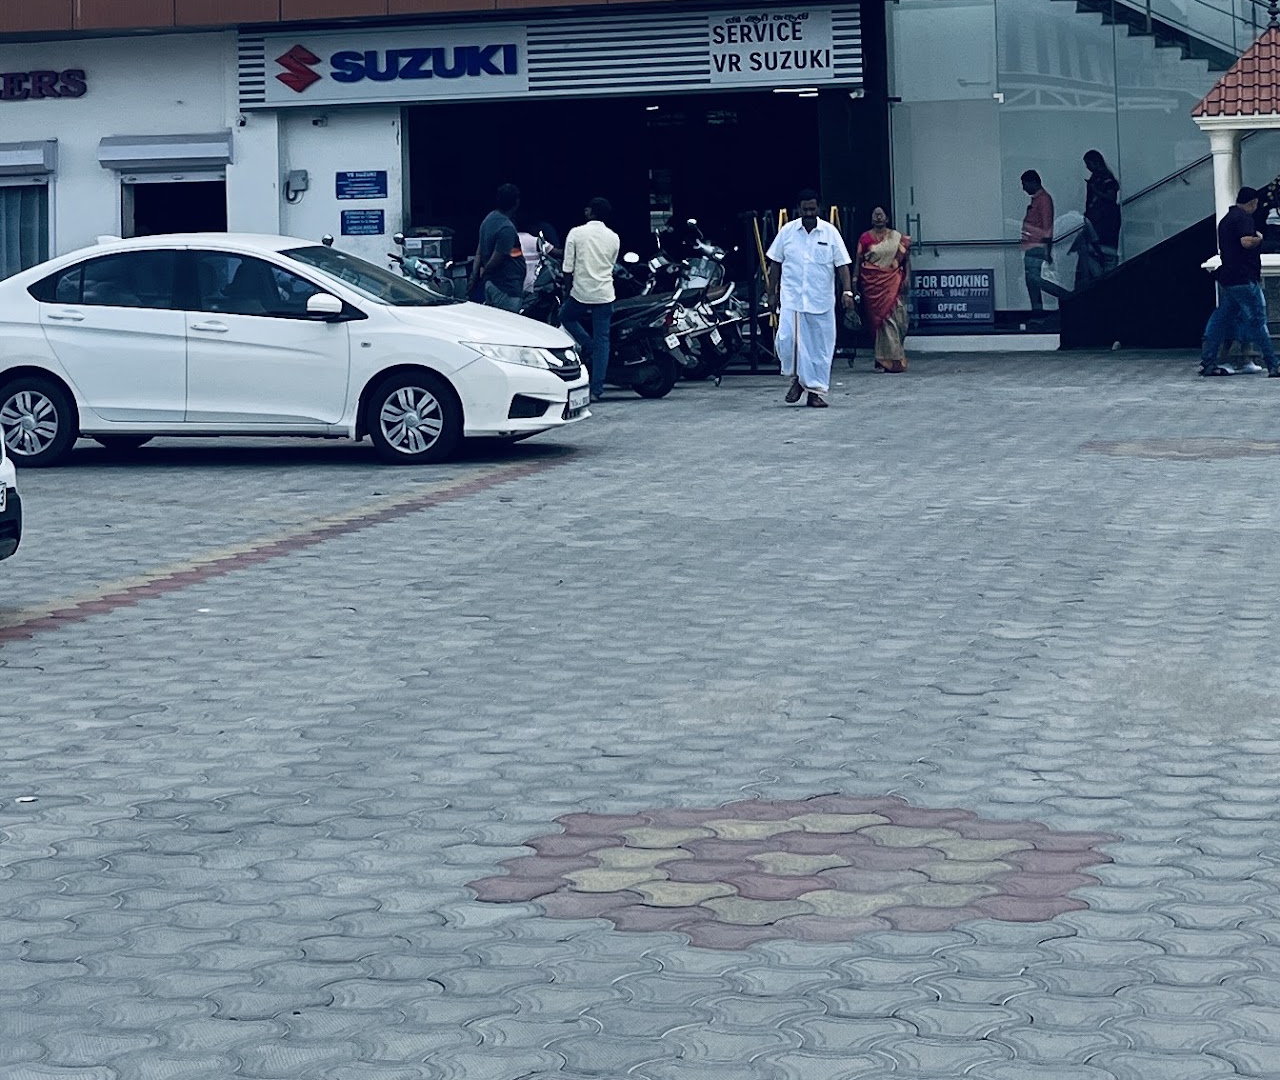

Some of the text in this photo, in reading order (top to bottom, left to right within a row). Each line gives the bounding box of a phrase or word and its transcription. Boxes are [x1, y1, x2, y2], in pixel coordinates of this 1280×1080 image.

[712, 22, 803, 44] SERVICE
[330, 43, 518, 83] SUZUKI
[713, 49, 830, 73] VR SUZUKI
[914, 274, 990, 289] FOR BOOKING
[937, 303, 968, 312] OFFICE
